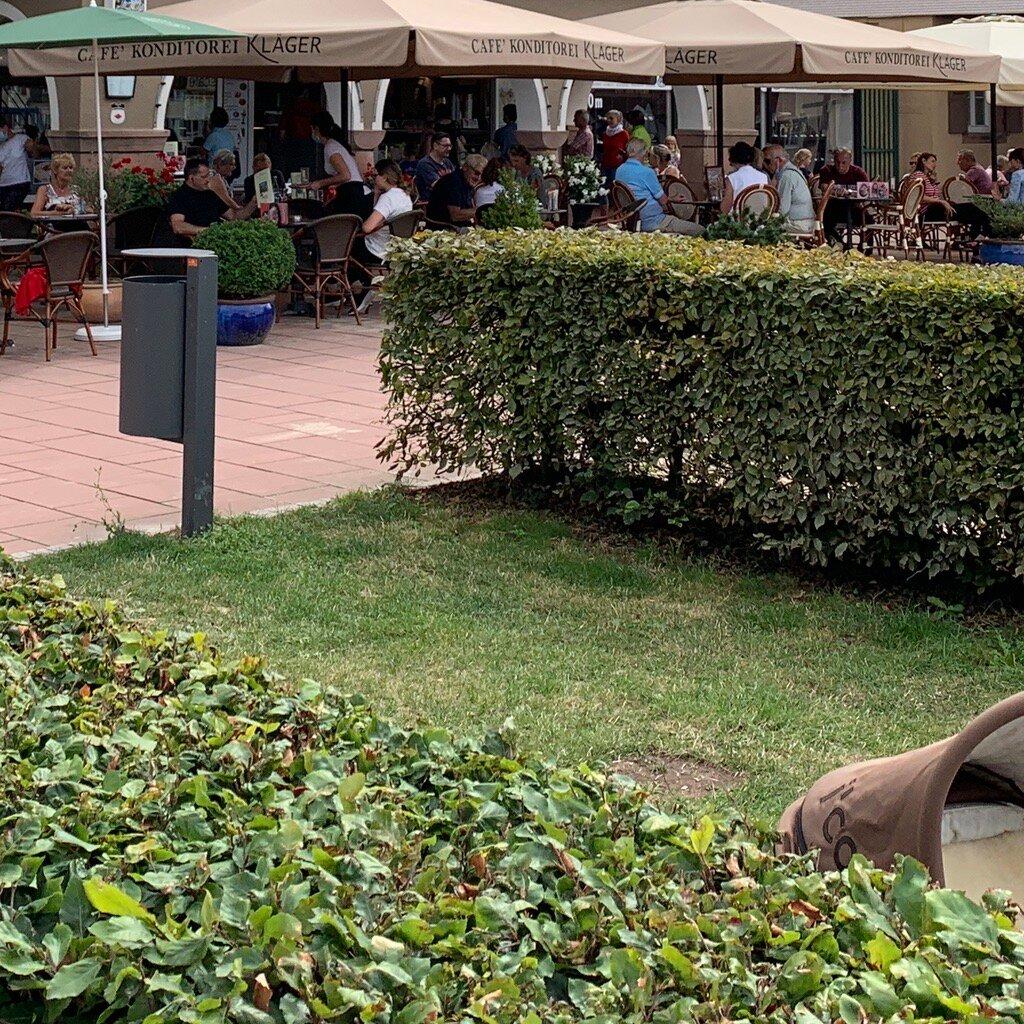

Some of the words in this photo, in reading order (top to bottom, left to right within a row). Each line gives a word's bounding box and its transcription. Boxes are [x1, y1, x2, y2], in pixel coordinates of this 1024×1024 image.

[132, 39, 238, 58] KONDITOREI
[246, 33, 321, 64] KLÄGER
[510, 38, 578, 58] KONDITOREI
[665, 46, 718, 72] LÄGER
[875, 52, 930, 67] KONDITOREI
